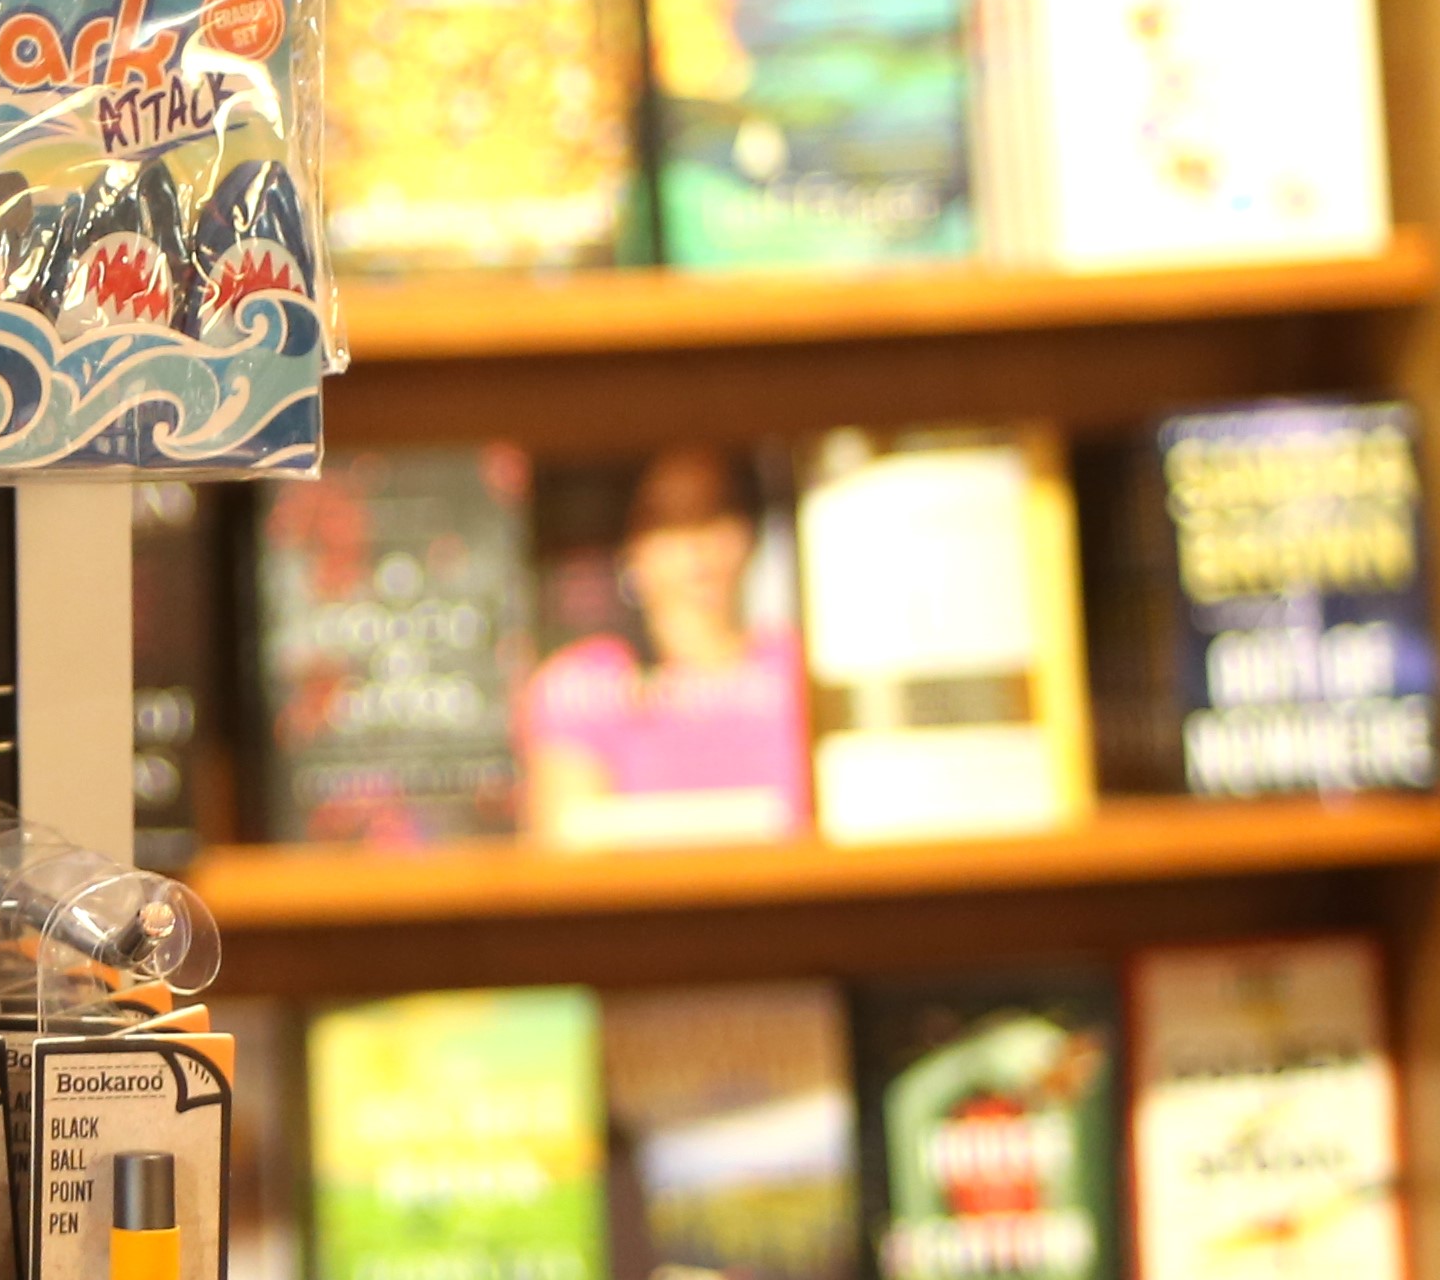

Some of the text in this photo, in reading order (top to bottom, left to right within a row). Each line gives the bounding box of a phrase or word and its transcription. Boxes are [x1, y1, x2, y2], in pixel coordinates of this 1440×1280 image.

[98, 71, 235, 154] ATTACK
[56, 1071, 164, 1095] Bookaroo
[50, 1116, 100, 1140] BLACK
[50, 1149, 88, 1172] BALL
[49, 1180, 95, 1204] POINT
[48, 1212, 80, 1236] PEN
